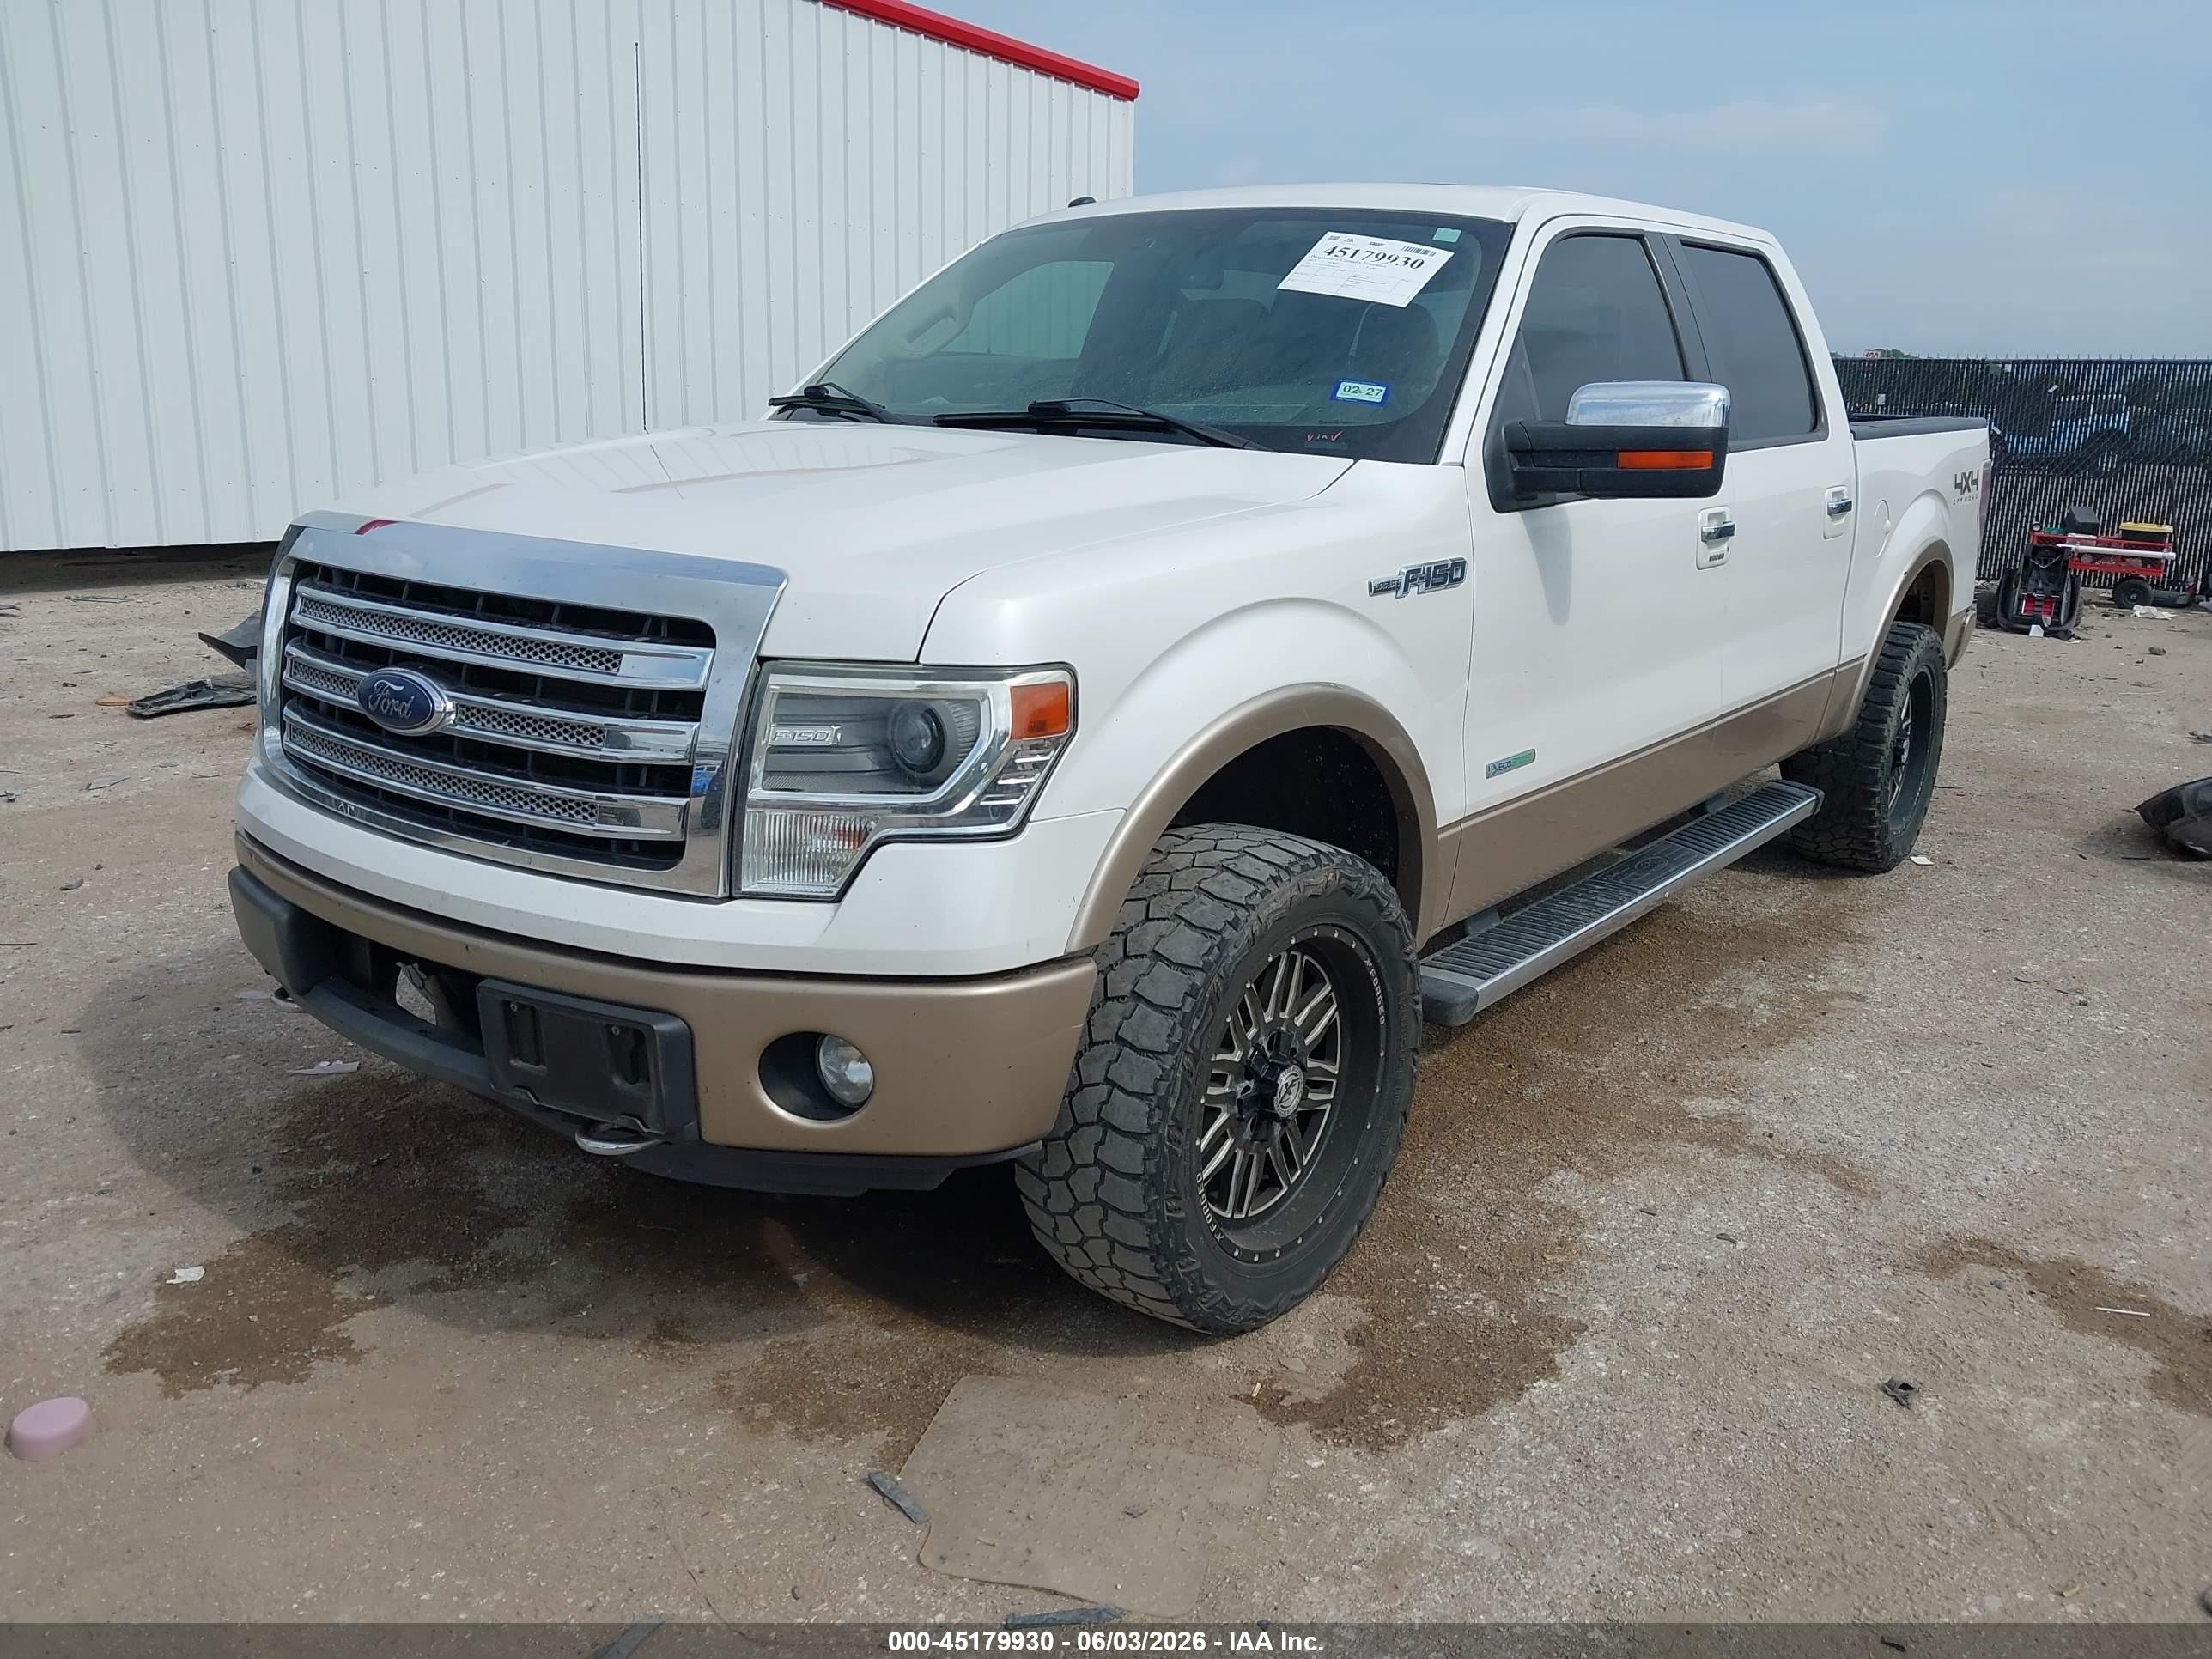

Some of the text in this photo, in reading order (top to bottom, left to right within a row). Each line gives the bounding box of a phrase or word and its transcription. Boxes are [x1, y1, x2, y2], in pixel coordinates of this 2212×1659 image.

[1322, 245, 1425, 270] 45179930
[1343, 385, 1383, 397] 02 27
[1397, 557, 1468, 599] F-150
[368, 679, 416, 719] Ford
